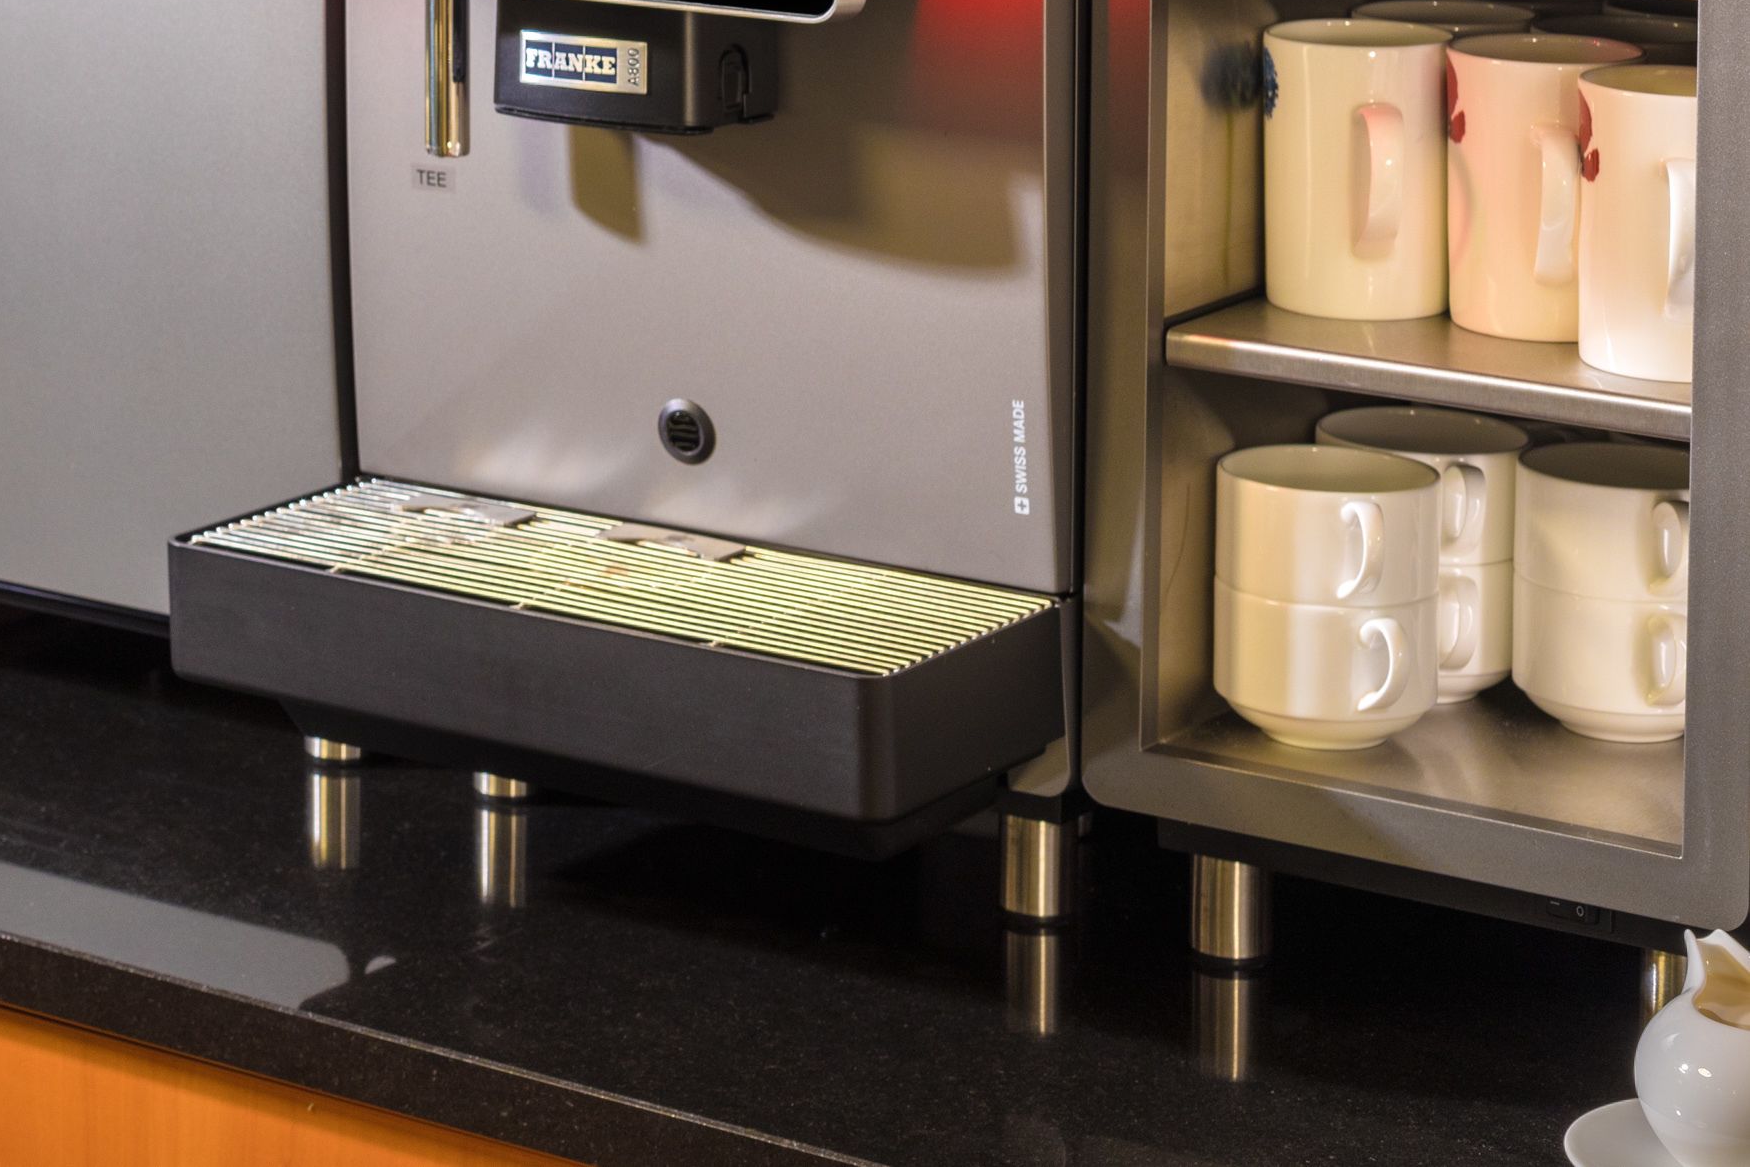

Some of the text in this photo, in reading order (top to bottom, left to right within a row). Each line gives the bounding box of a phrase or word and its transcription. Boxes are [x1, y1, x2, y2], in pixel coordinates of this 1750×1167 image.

[525, 48, 615, 76] FRANKE
[627, 47, 641, 87] A800
[416, 169, 447, 188] TEE
[1012, 399, 1028, 494] SWISS MADE
